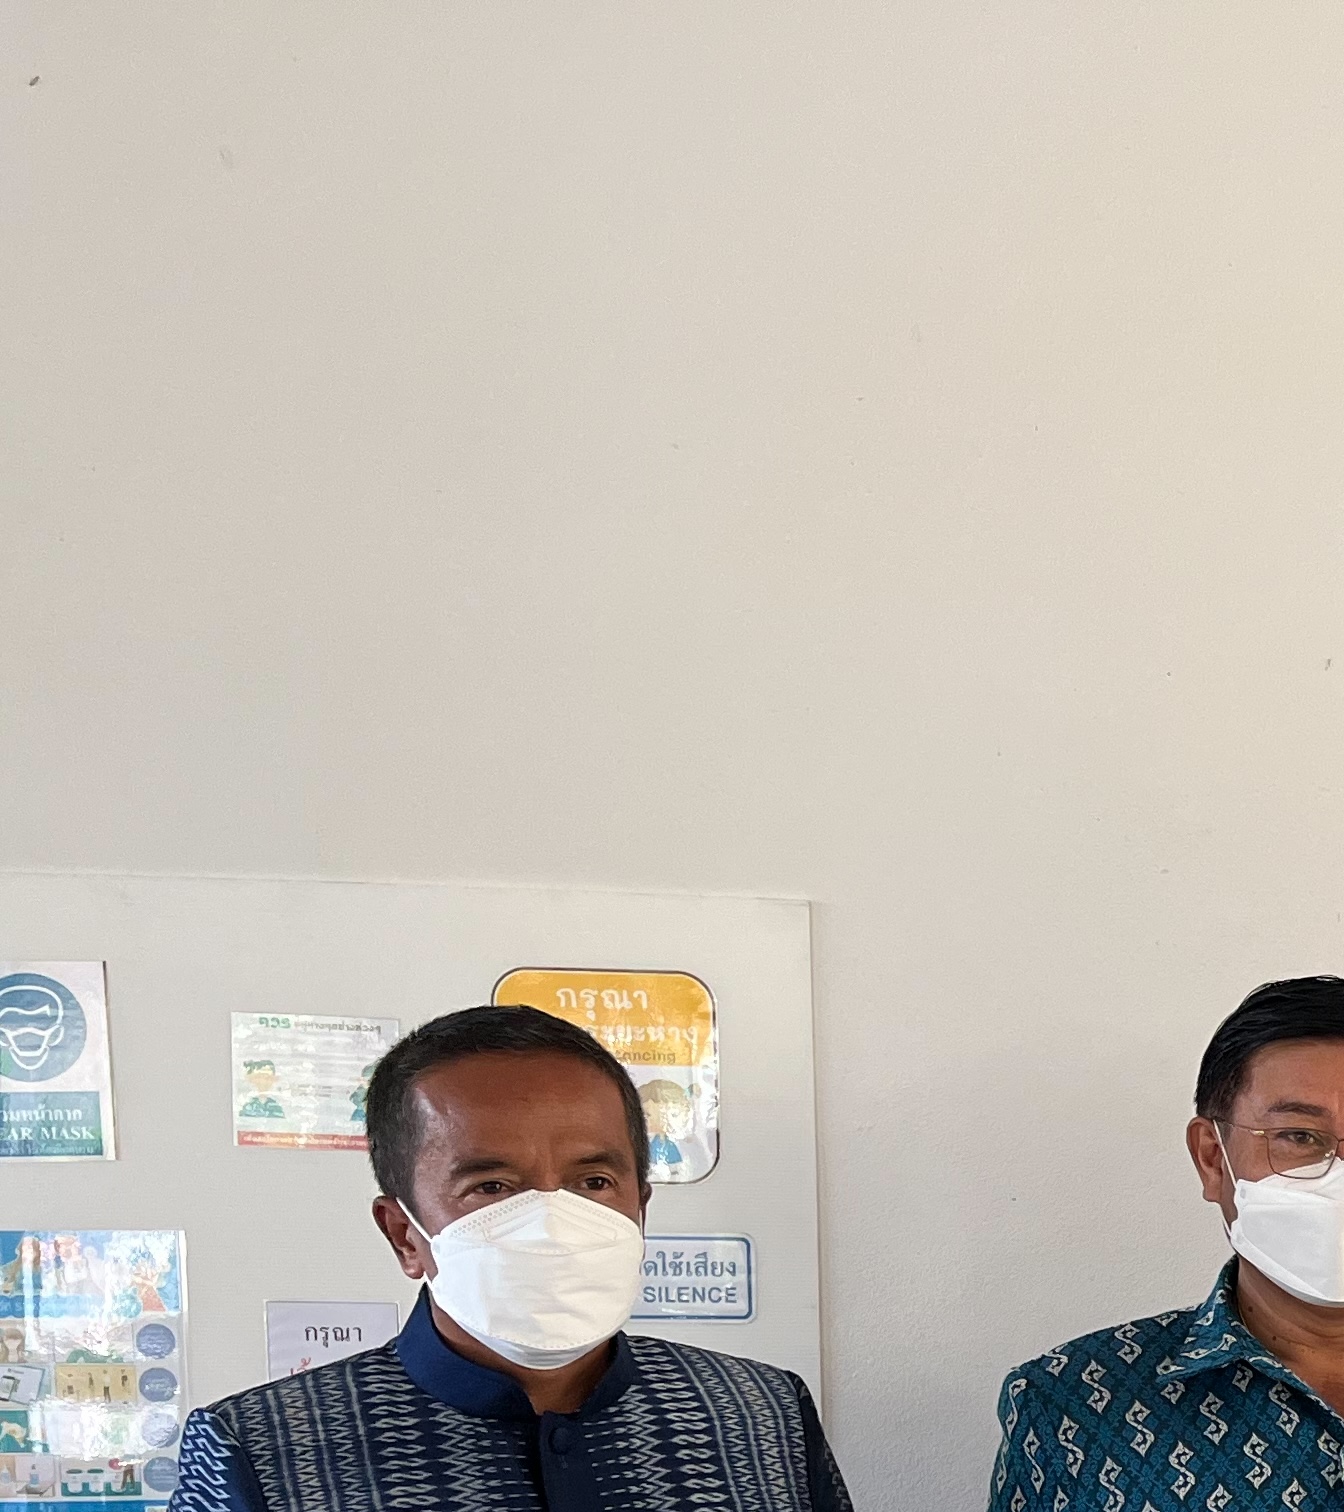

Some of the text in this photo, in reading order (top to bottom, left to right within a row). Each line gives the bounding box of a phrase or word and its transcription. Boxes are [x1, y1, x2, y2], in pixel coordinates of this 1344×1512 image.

[556, 987, 649, 1021] กรุณา
[41, 1126, 96, 1141] MASK
[639, 1250, 737, 1277] ดใช้เสียง
[642, 1286, 738, 1304] SILENCE
[304, 1325, 363, 1349] กรุณา
